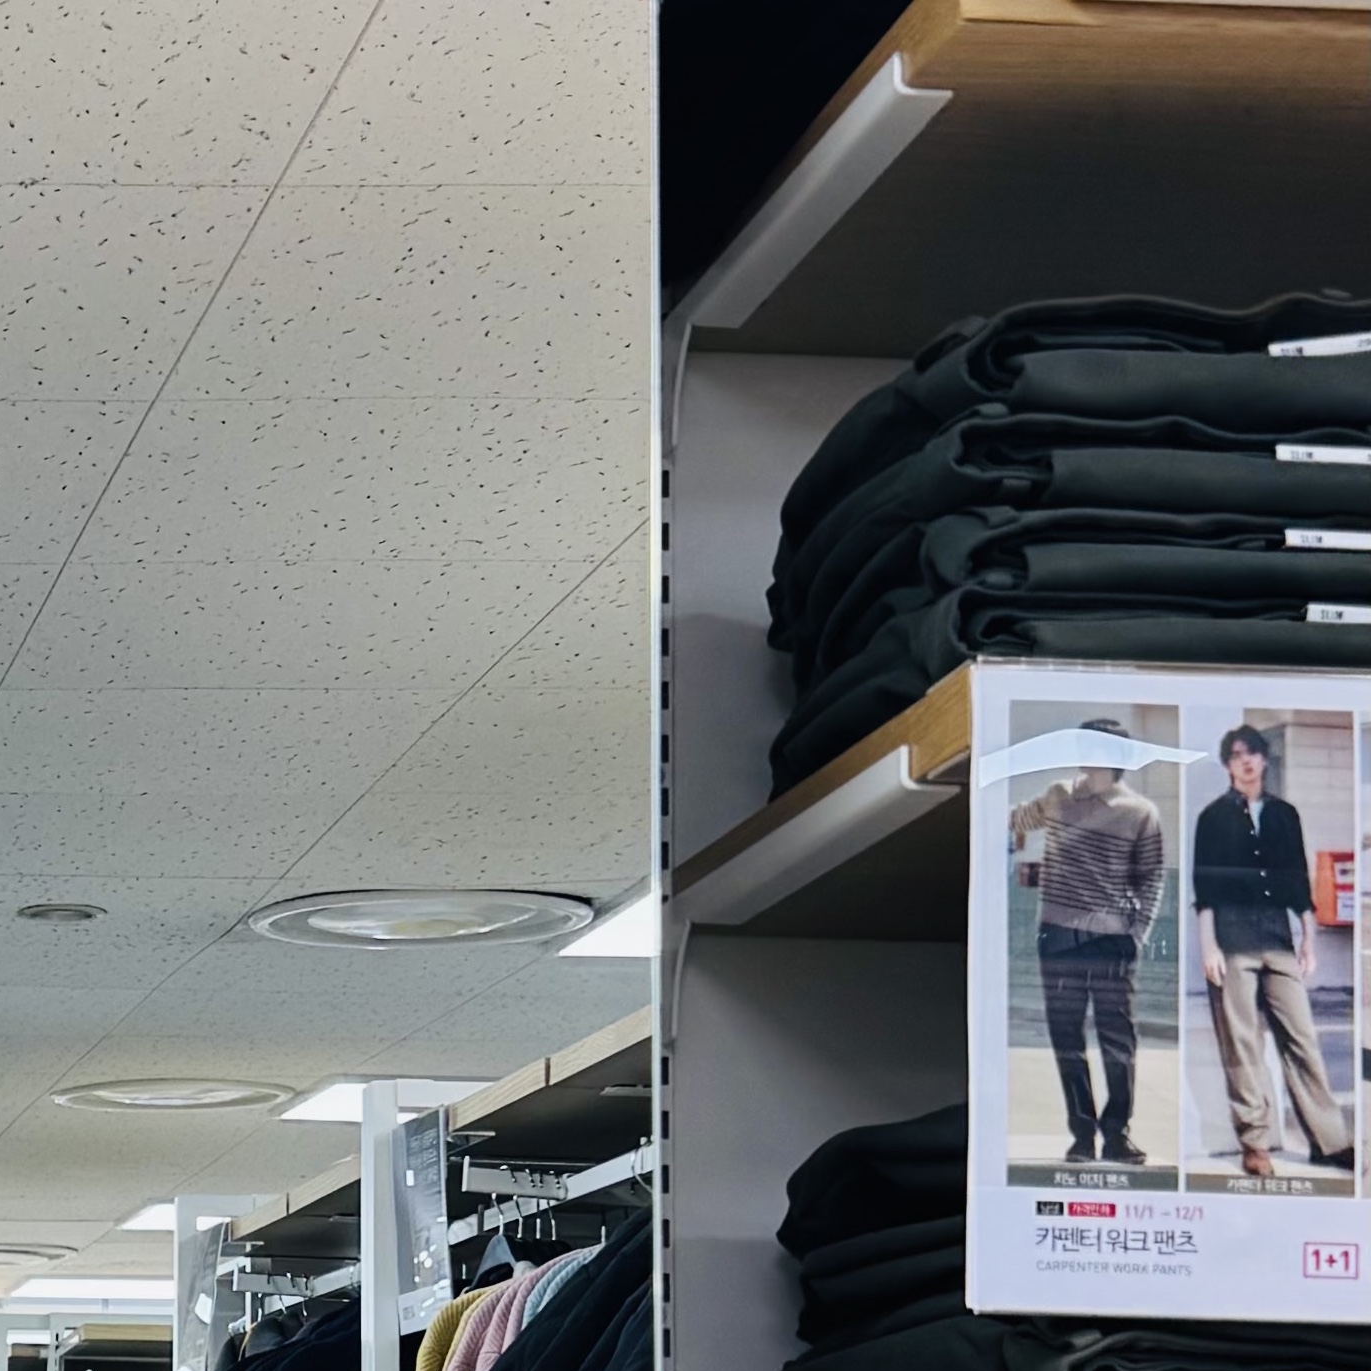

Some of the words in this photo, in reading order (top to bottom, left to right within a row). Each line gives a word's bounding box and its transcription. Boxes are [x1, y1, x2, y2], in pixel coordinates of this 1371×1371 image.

[1124, 1204, 1154, 1220] 11/1
[1175, 1206, 1205, 1221] 12/1
[1035, 1226, 1102, 1253] 카펜터
[1106, 1228, 1151, 1254] 워크
[1153, 1229, 1199, 1256] 팬츠
[1036, 1260, 1110, 1274] CARPENTER
[1112, 1262, 1149, 1275] WORK
[1152, 1263, 1193, 1277] PANTS
[1311, 1248, 1350, 1272] 1+1
